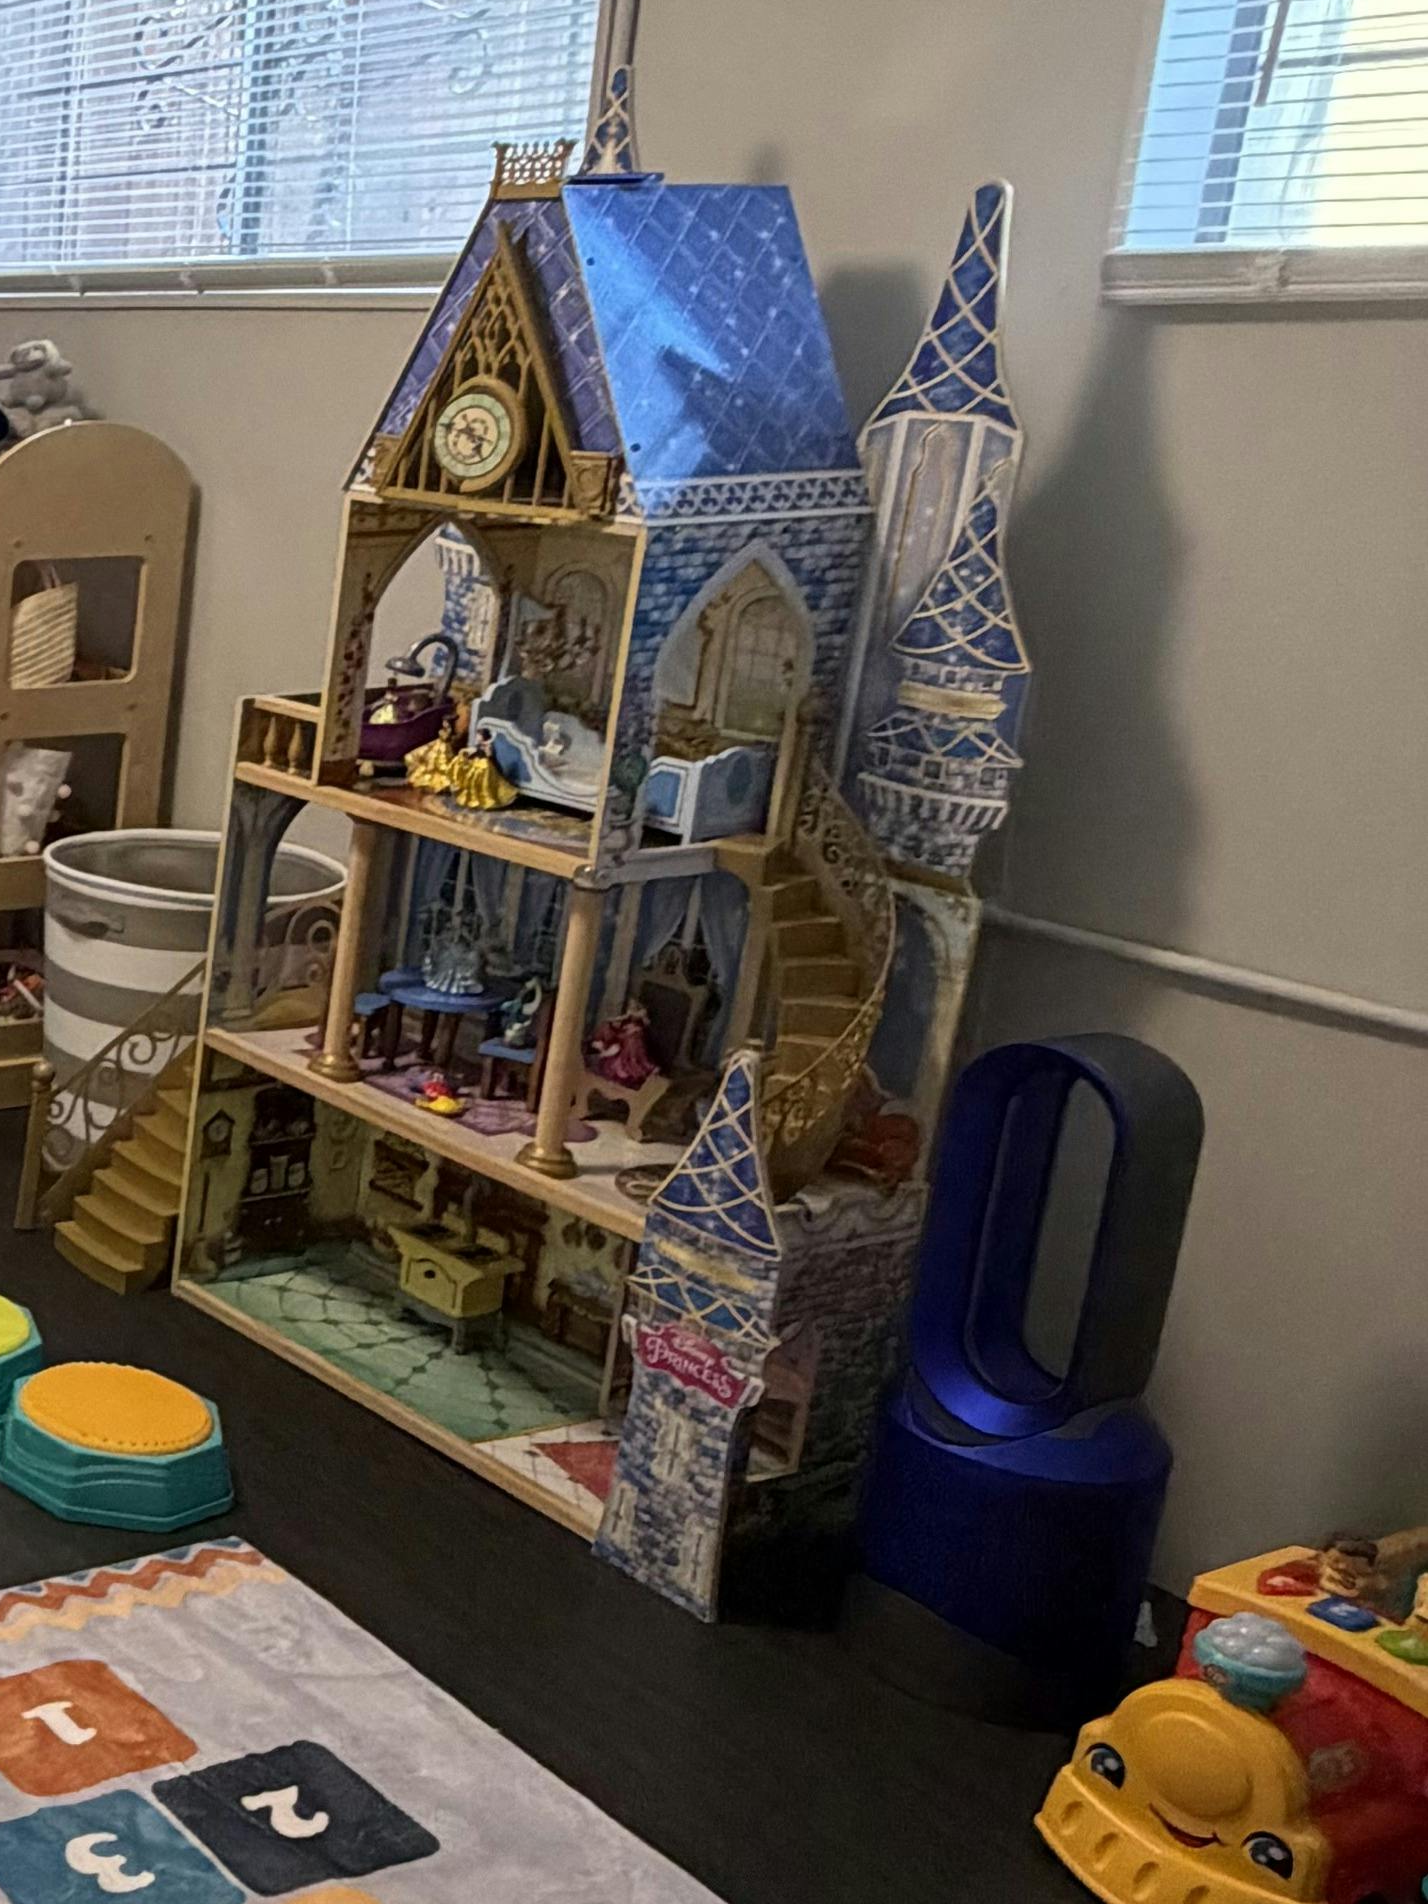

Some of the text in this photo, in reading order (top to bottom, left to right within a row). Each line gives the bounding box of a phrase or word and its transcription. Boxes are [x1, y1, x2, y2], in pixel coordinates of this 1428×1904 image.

[22, 1701, 97, 1745] 1
[239, 1784, 330, 1840] 2
[64, 1831, 155, 1894] 3
